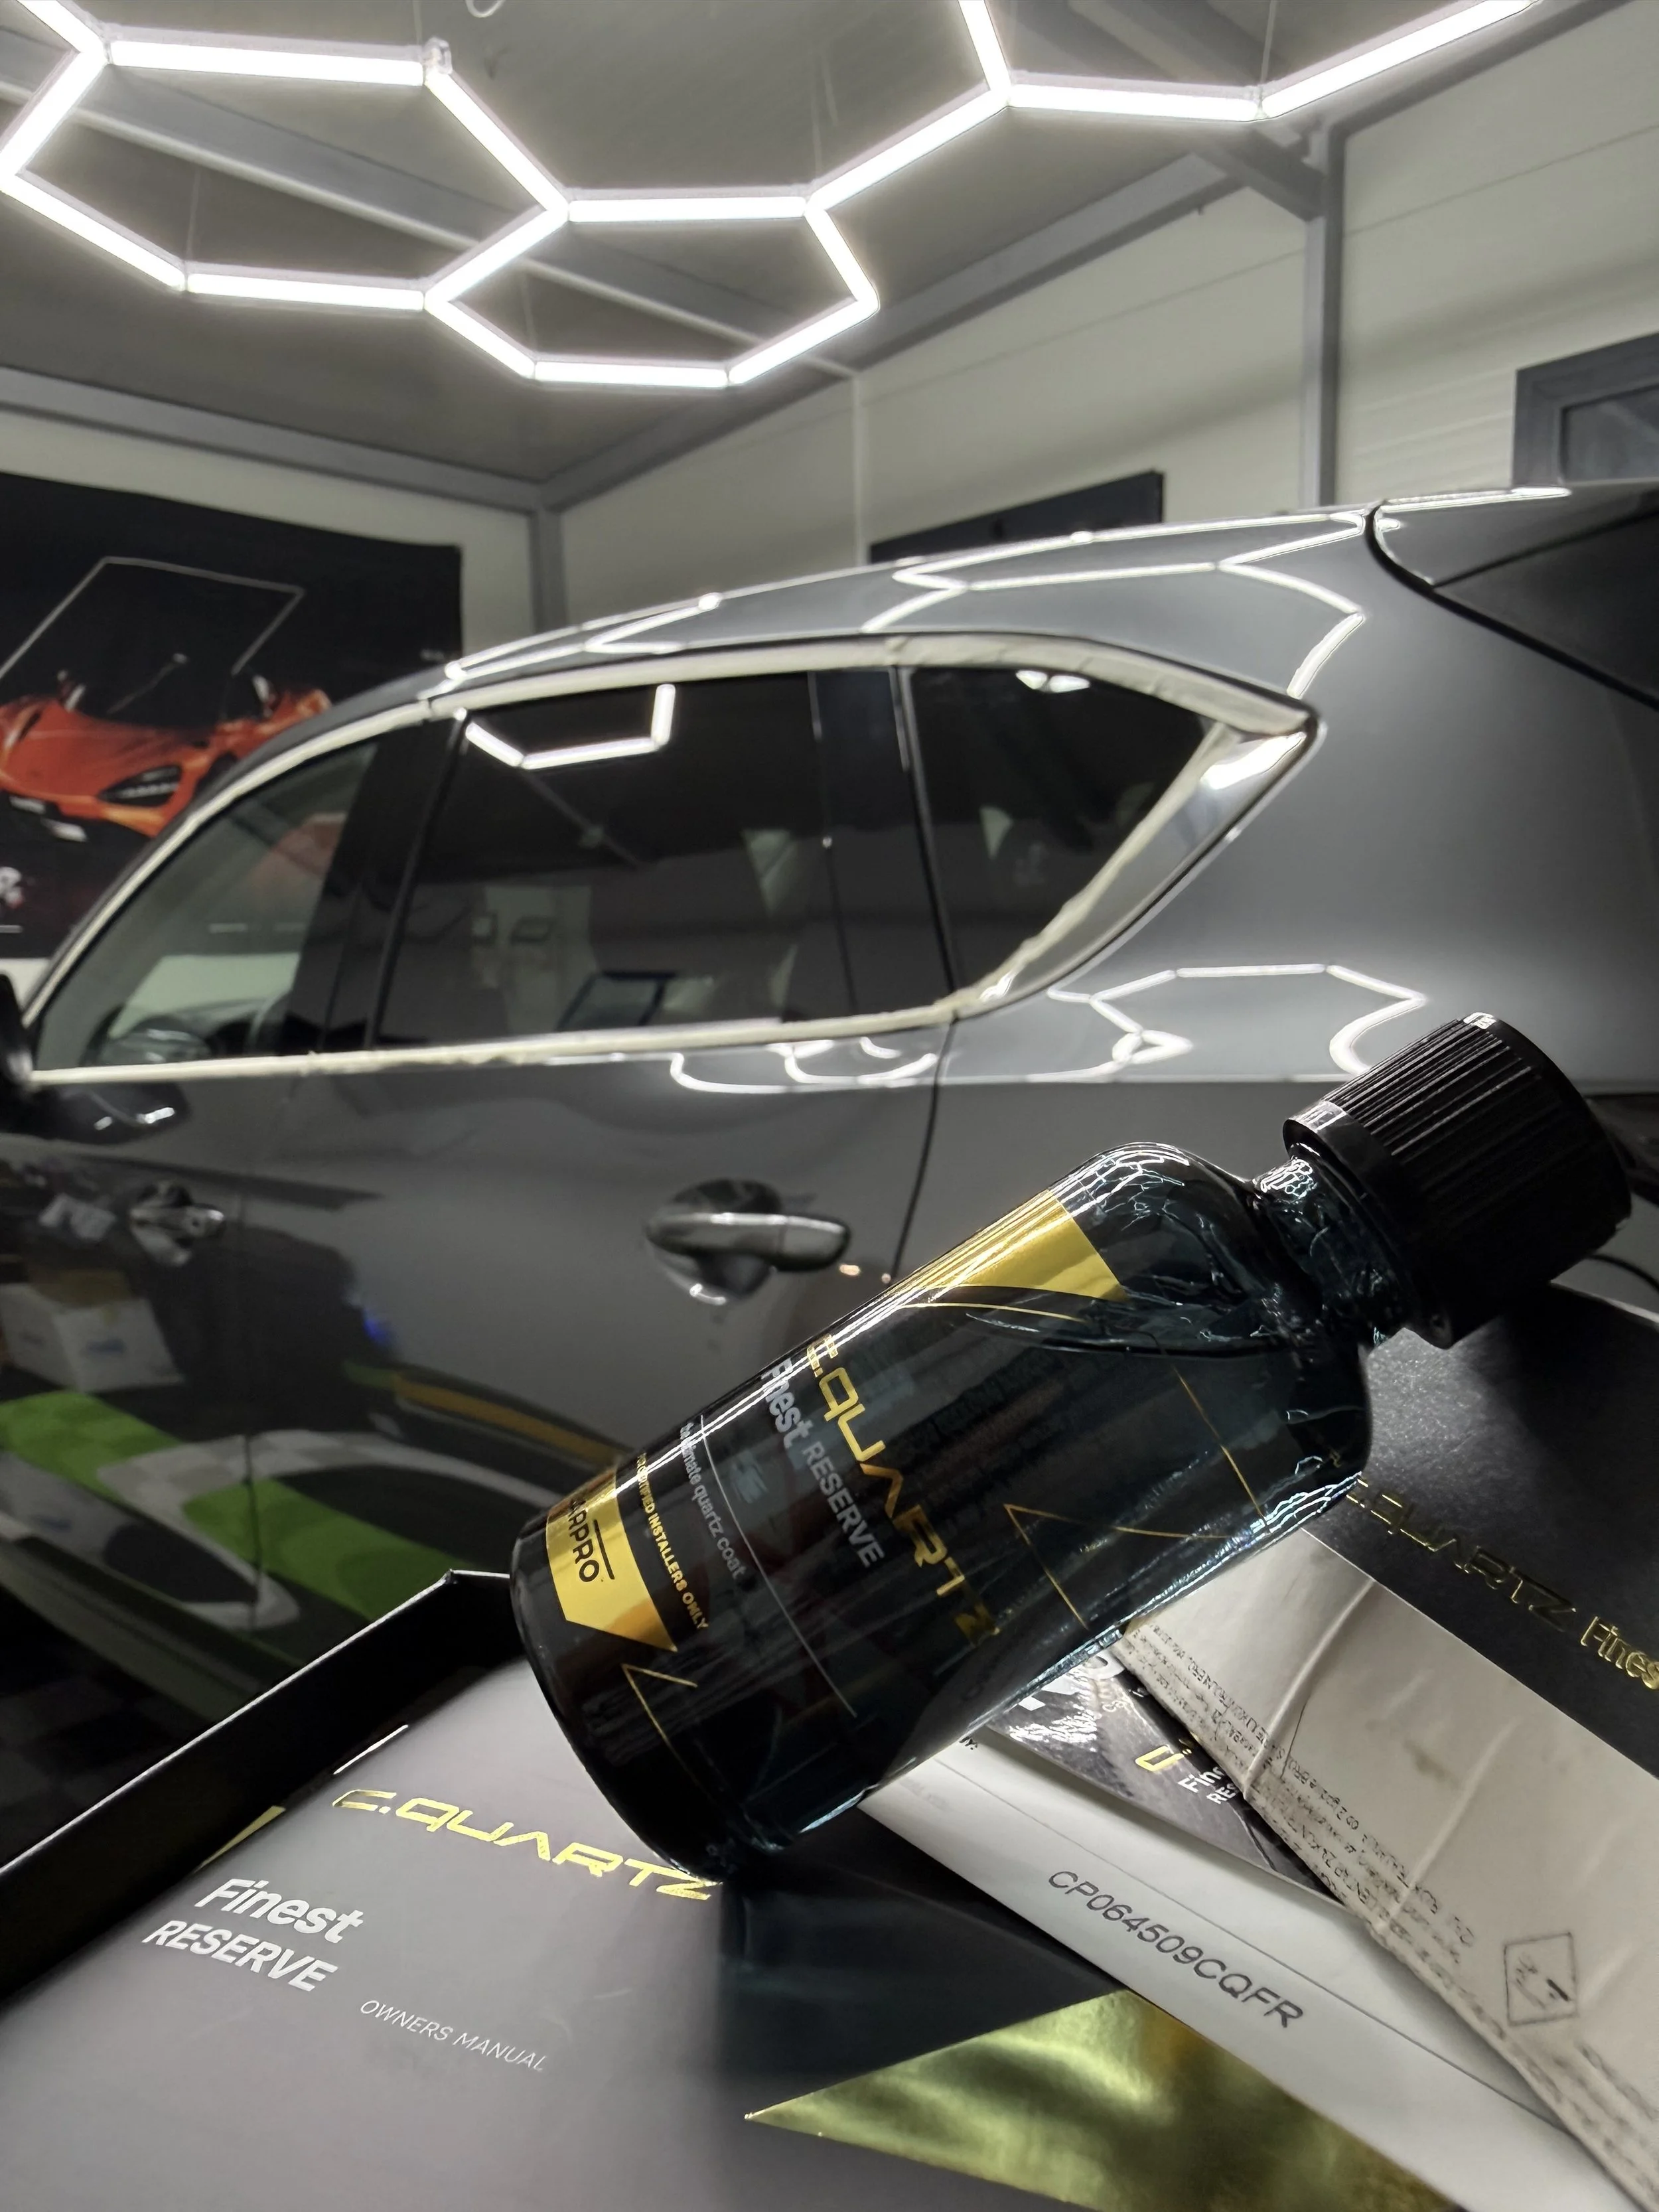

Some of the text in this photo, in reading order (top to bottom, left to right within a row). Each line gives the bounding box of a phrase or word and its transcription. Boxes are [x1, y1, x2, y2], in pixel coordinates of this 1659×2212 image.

[761, 1357, 886, 1568] Fnest RESERVE
[648, 1512, 687, 1592] INSTALLERS
[682, 1591, 709, 1630] ONLY
[691, 1485, 724, 1538] quartz
[717, 1537, 747, 1580] coat
[332, 1789, 723, 1900] C.QUARTZ
[141, 1919, 339, 1992] RESERVE
[194, 1878, 364, 1945] Finest
[1048, 1870, 1304, 2029] CP064509CQFR
[360, 1999, 547, 2071] OWNERS MANUAL
